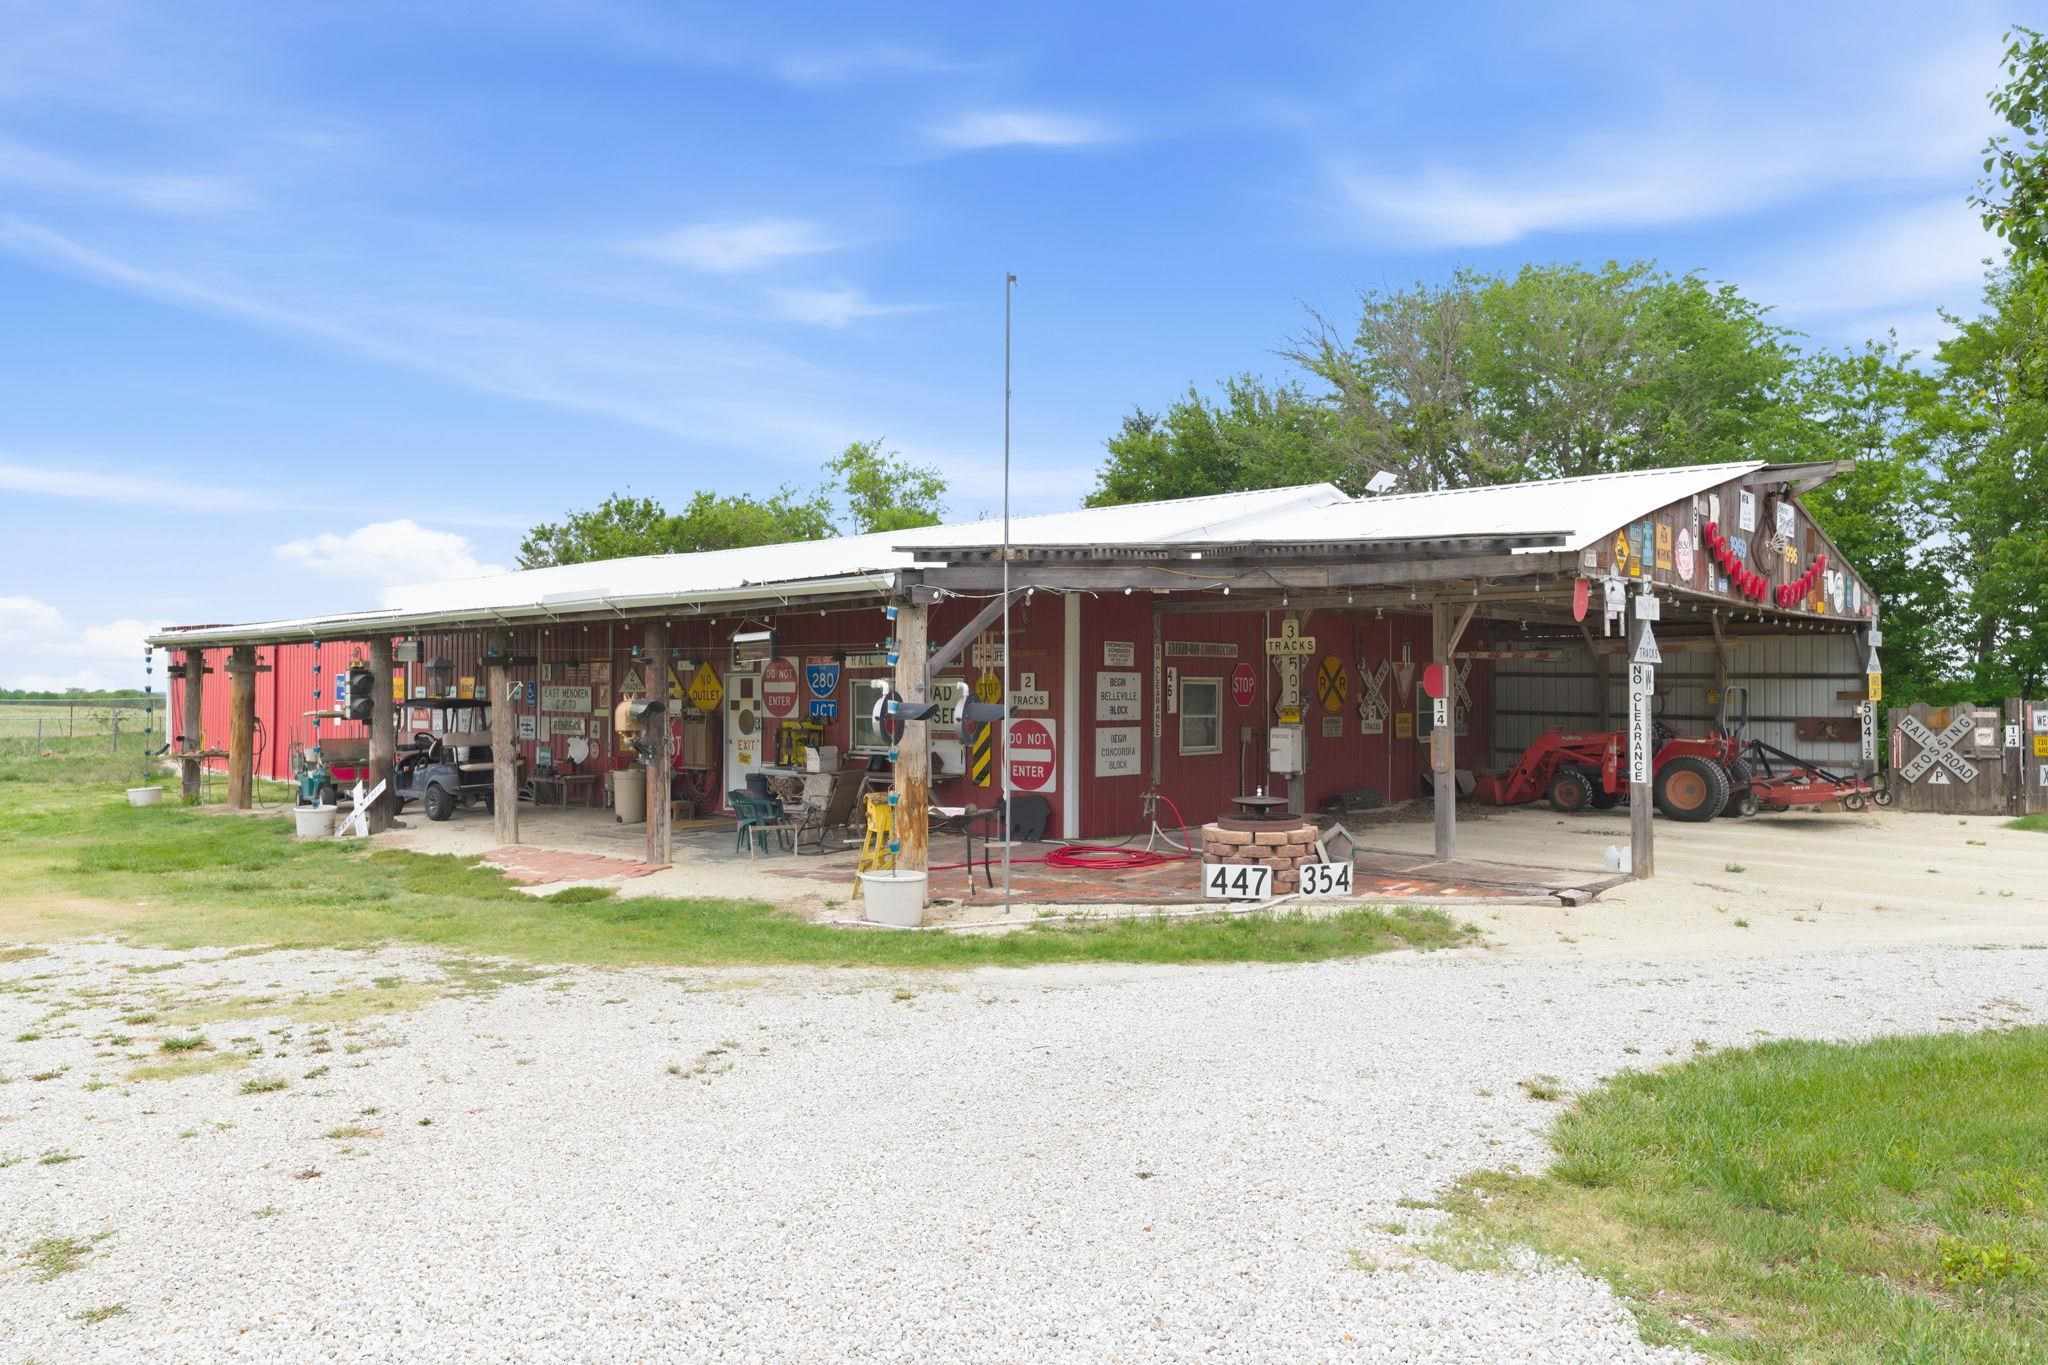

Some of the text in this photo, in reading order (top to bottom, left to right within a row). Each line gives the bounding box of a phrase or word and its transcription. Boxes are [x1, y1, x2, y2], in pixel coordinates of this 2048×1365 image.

[1287, 625, 1295, 639] 3
[1268, 641, 1314, 651] TRACKS
[851, 655, 873, 666] RAIL
[630, 672, 635, 681] 2
[701, 674, 711, 686] NO
[766, 669, 792, 679] DO NOT
[812, 672, 835, 689] 280
[1025, 676, 1031, 688] 2
[1110, 678, 1127, 687] BEGIN
[1233, 677, 1255, 693] STOP
[1320, 677, 1346, 690] R R
[544, 689, 589, 699] EAST MENOKEN
[693, 690, 720, 701] OUTLET
[978, 683, 998, 696] STOP
[768, 696, 791, 706] ENTER
[1013, 691, 1045, 705] TRACKS
[1101, 692, 1137, 701] BELLEVILLE
[812, 704, 835, 717] JCT
[1109, 705, 1128, 715] BLOCK
[1633, 665, 1643, 782] NO CLEARANCE
[1863, 702, 1872, 737] 504
[592, 723, 598, 736] 4
[1010, 733, 1048, 745] DO NOT
[1110, 734, 1127, 743] BEGIN
[738, 740, 755, 750] EXIT
[1902, 718, 1974, 779] RAIL ROAD
[1904, 718, 1971, 780] CROSSING
[1101, 747, 1136, 757] CONCORDIA
[1108, 760, 1128, 769] BLOCK
[1012, 765, 1044, 778] ENTER
[1935, 771, 1943, 782] P
[1211, 867, 1268, 896] 447
[1303, 865, 1349, 895] 354
